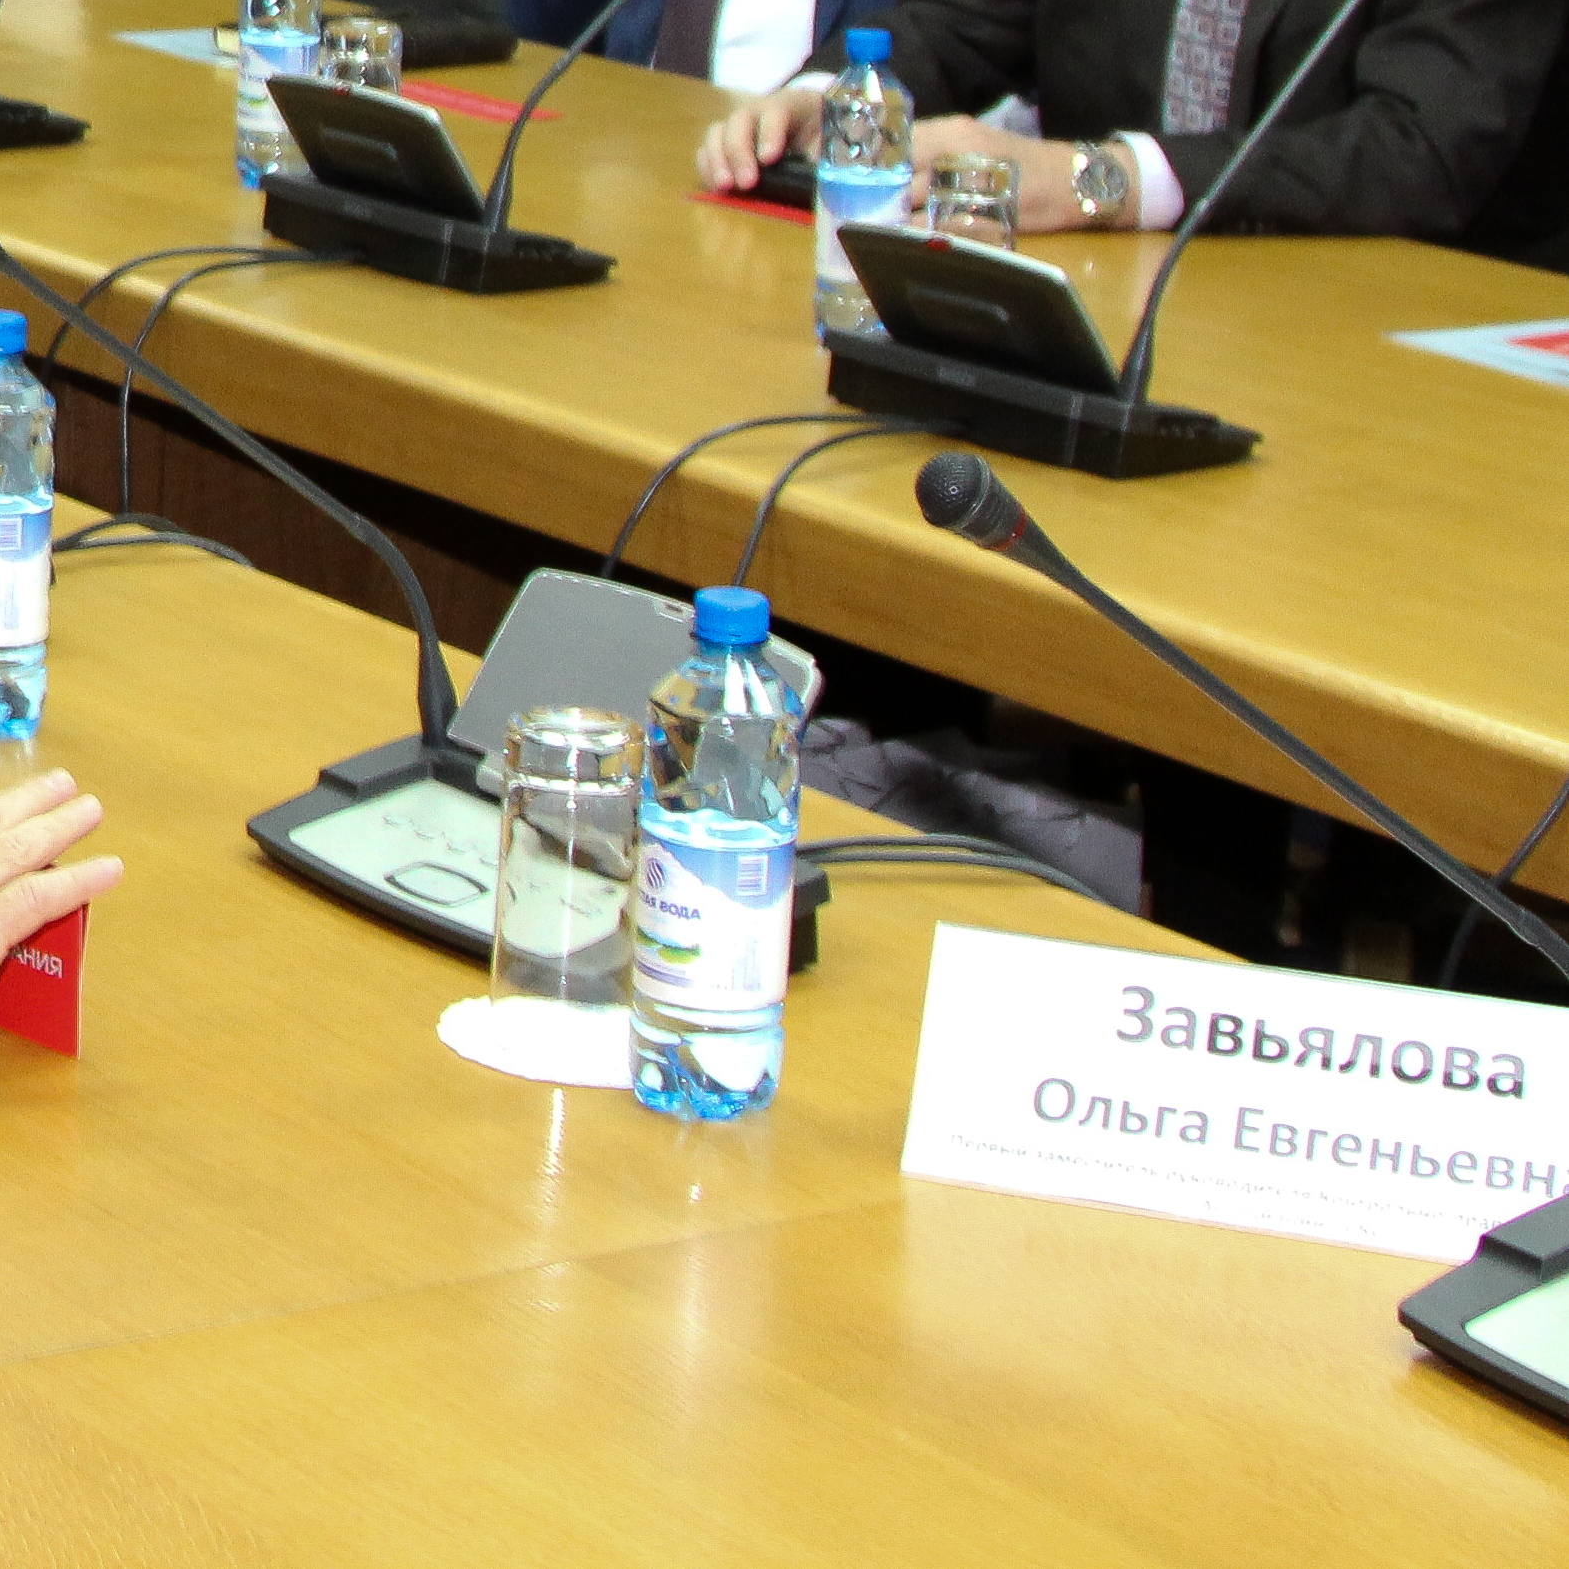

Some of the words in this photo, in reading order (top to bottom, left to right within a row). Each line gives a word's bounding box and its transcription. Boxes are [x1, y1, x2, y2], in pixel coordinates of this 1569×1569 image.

[659, 900, 701, 920] ВОДА
[1116, 985, 1525, 1100] Завьялова
[1033, 1077, 1210, 1146] Ольга
[1233, 1106, 1569, 1199] Евгеньевн
